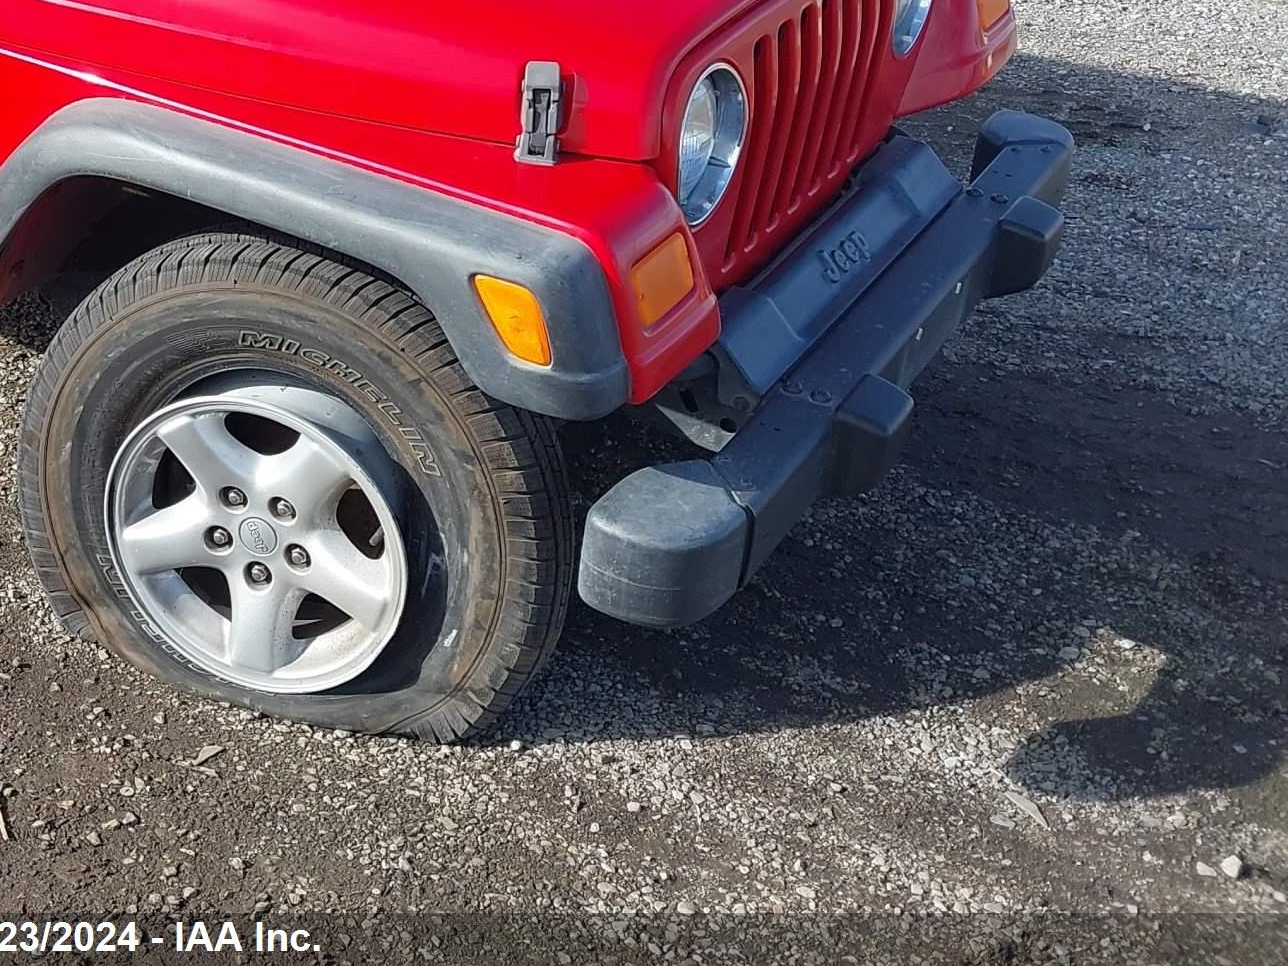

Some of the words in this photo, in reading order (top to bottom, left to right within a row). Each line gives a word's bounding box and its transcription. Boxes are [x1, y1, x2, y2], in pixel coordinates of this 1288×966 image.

[816, 231, 871, 284] Jeep
[238, 330, 441, 477] MICHELIN
[247, 521, 269, 553] Jeep
